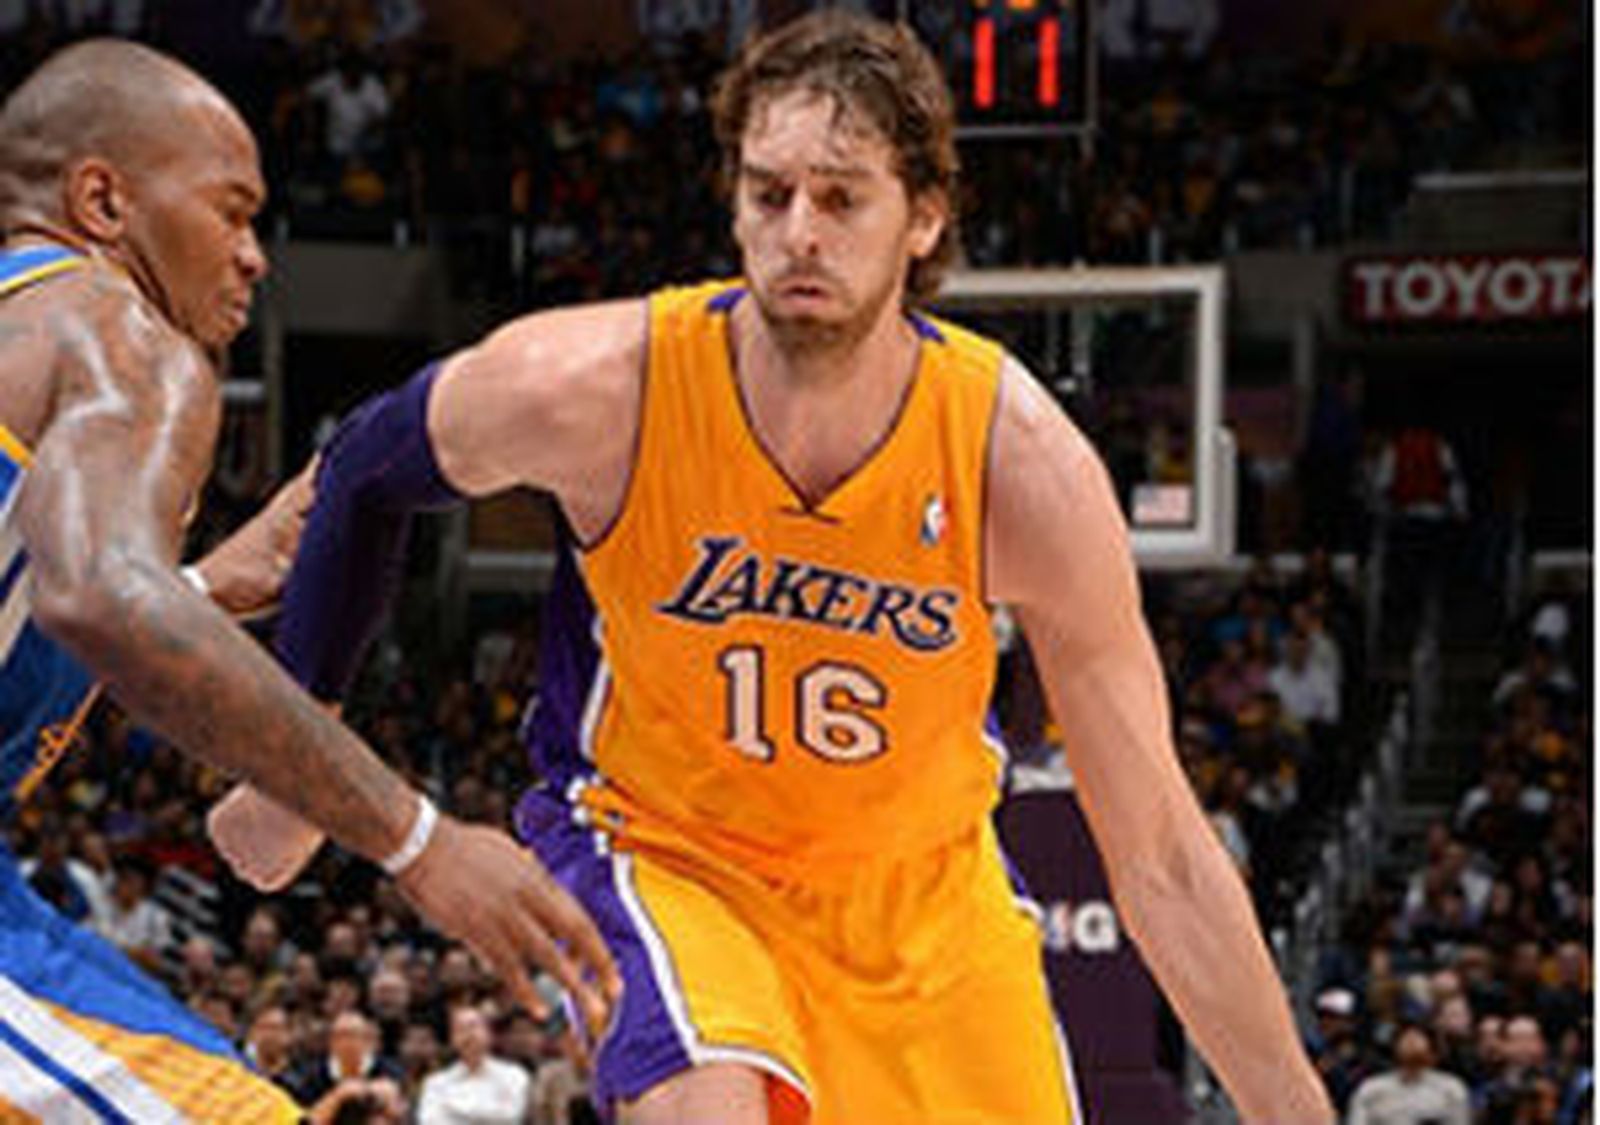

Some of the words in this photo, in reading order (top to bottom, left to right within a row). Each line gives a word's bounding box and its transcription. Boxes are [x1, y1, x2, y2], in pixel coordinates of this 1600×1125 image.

[974, 18, 1060, 108] 11
[656, 536, 960, 652] LAKERS
[717, 644, 889, 763] 16
